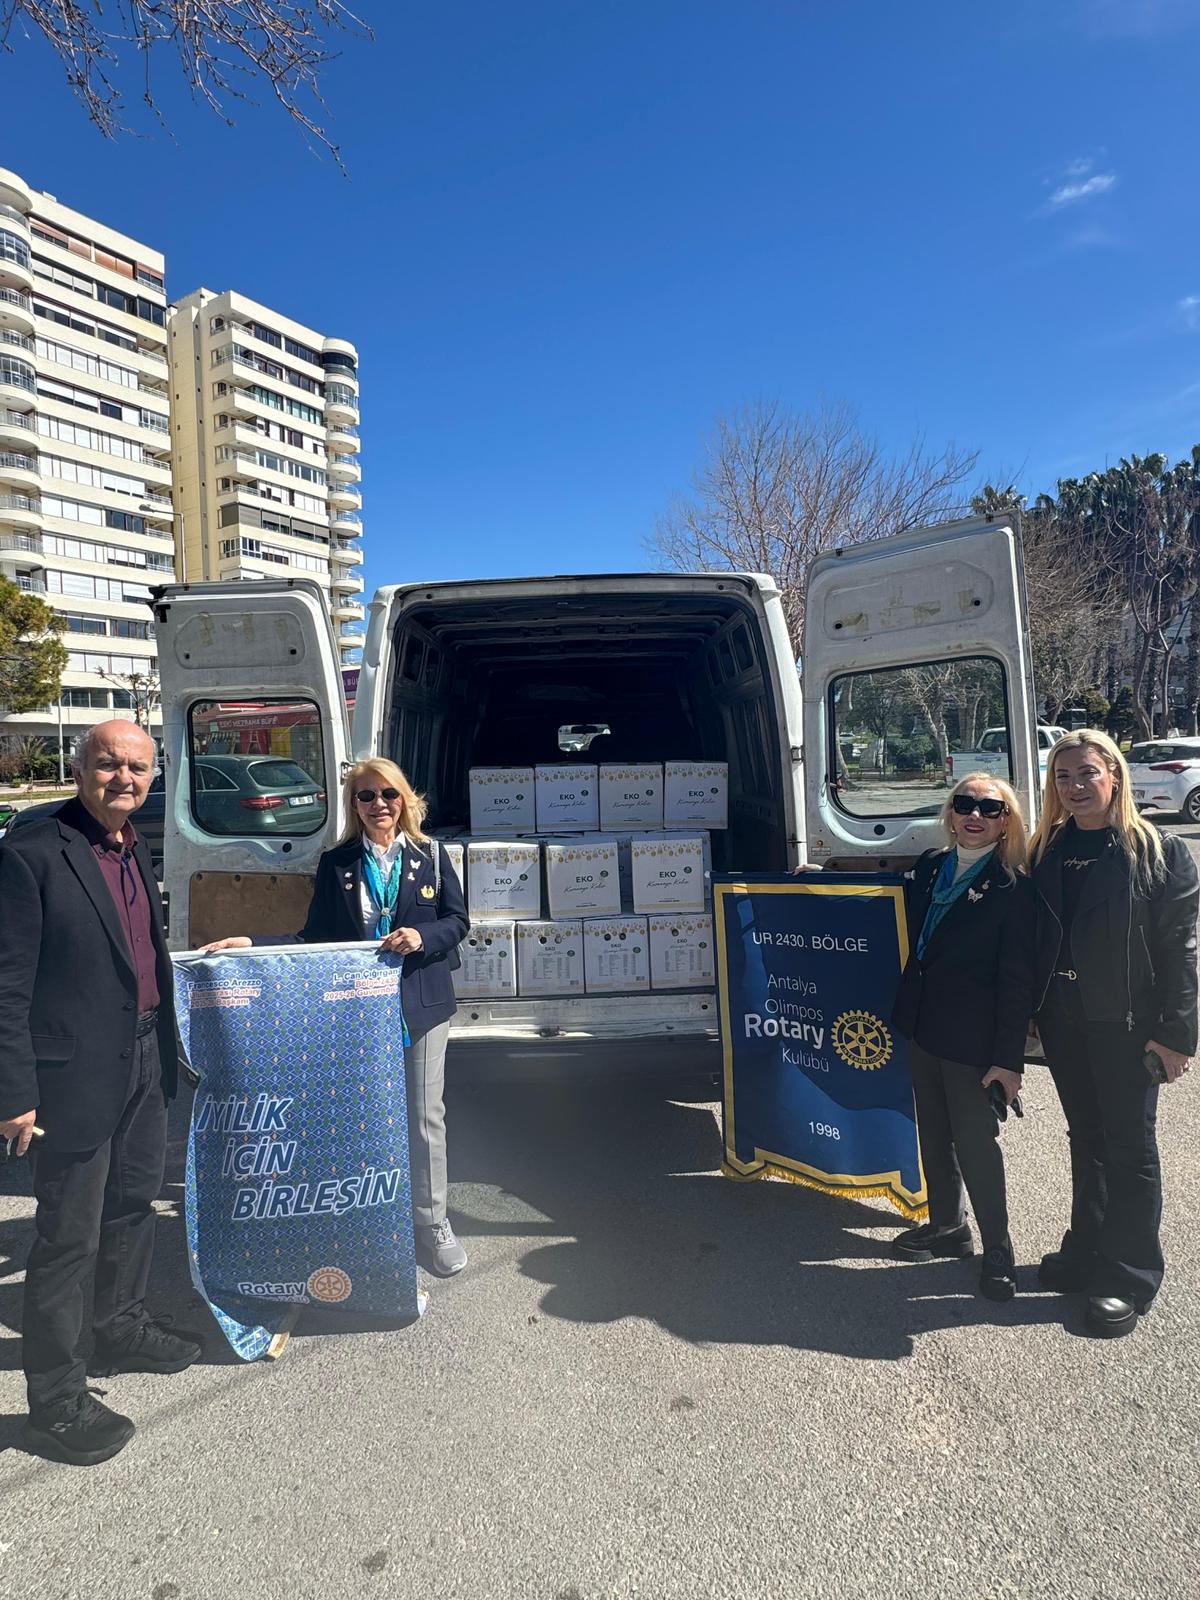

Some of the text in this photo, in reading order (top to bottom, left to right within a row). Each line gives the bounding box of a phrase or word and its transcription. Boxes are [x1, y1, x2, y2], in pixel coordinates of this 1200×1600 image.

[576, 874, 593, 883] EKO
[659, 870, 676, 878] EKO
[752, 931, 868, 952] UR 2430. BÖLGE
[188, 978, 261, 990] Francesco Arezzo
[344, 972, 360, 980] Can
[767, 973, 817, 996] Antalya
[233, 988, 260, 997] Rotary
[325, 990, 355, 1000] 2025-26
[765, 998, 824, 1021] Olimpos
[744, 1013, 824, 1049] Rotary
[782, 1047, 830, 1073] Kulübü
[197, 1093, 293, 1132] İYİLİK
[808, 1121, 841, 1140] 1998
[222, 1136, 297, 1181] İÇİN
[231, 1167, 400, 1220] BİRLEŞİN
[238, 1282, 305, 1297] Rotary
